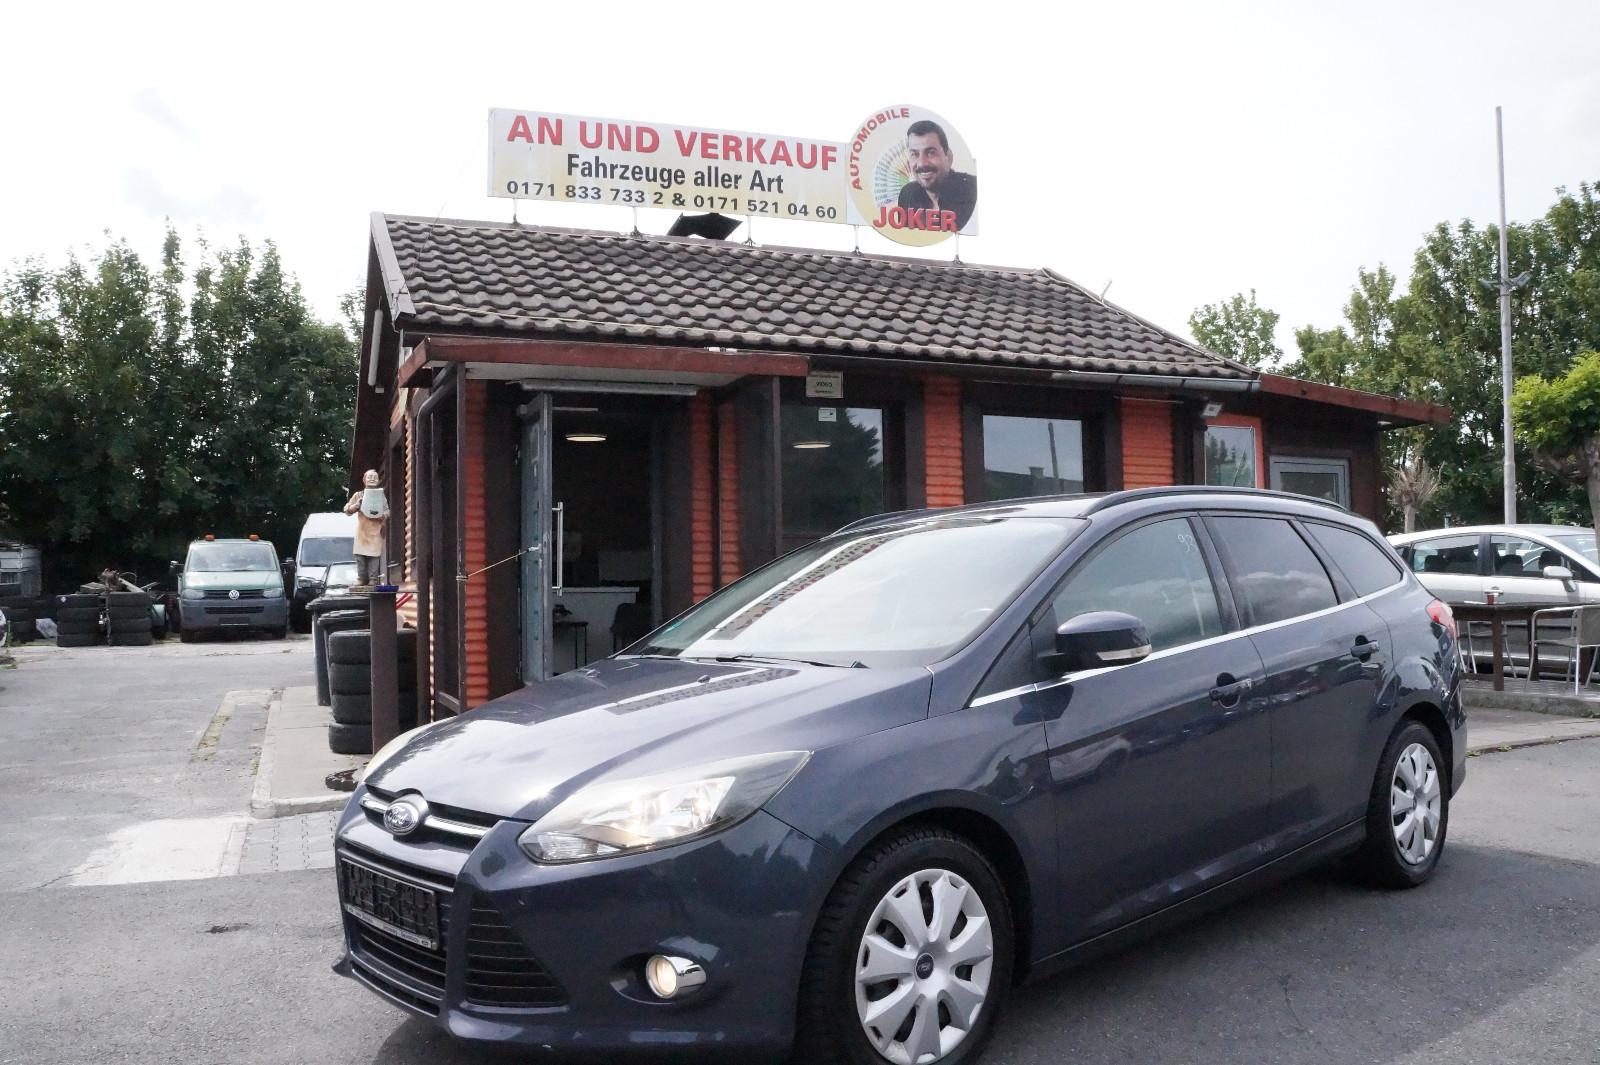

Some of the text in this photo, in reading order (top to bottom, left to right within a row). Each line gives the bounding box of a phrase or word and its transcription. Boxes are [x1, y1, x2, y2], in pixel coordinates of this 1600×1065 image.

[507, 115, 837, 171] AN UND VERKAUF
[850, 107, 910, 191] AUTOMOBILE
[567, 153, 784, 194] Fahrzeuge aller Art
[506, 180, 837, 219] 0171 833 733 2 & 0171 521 04 60
[872, 206, 958, 233] JOKER
